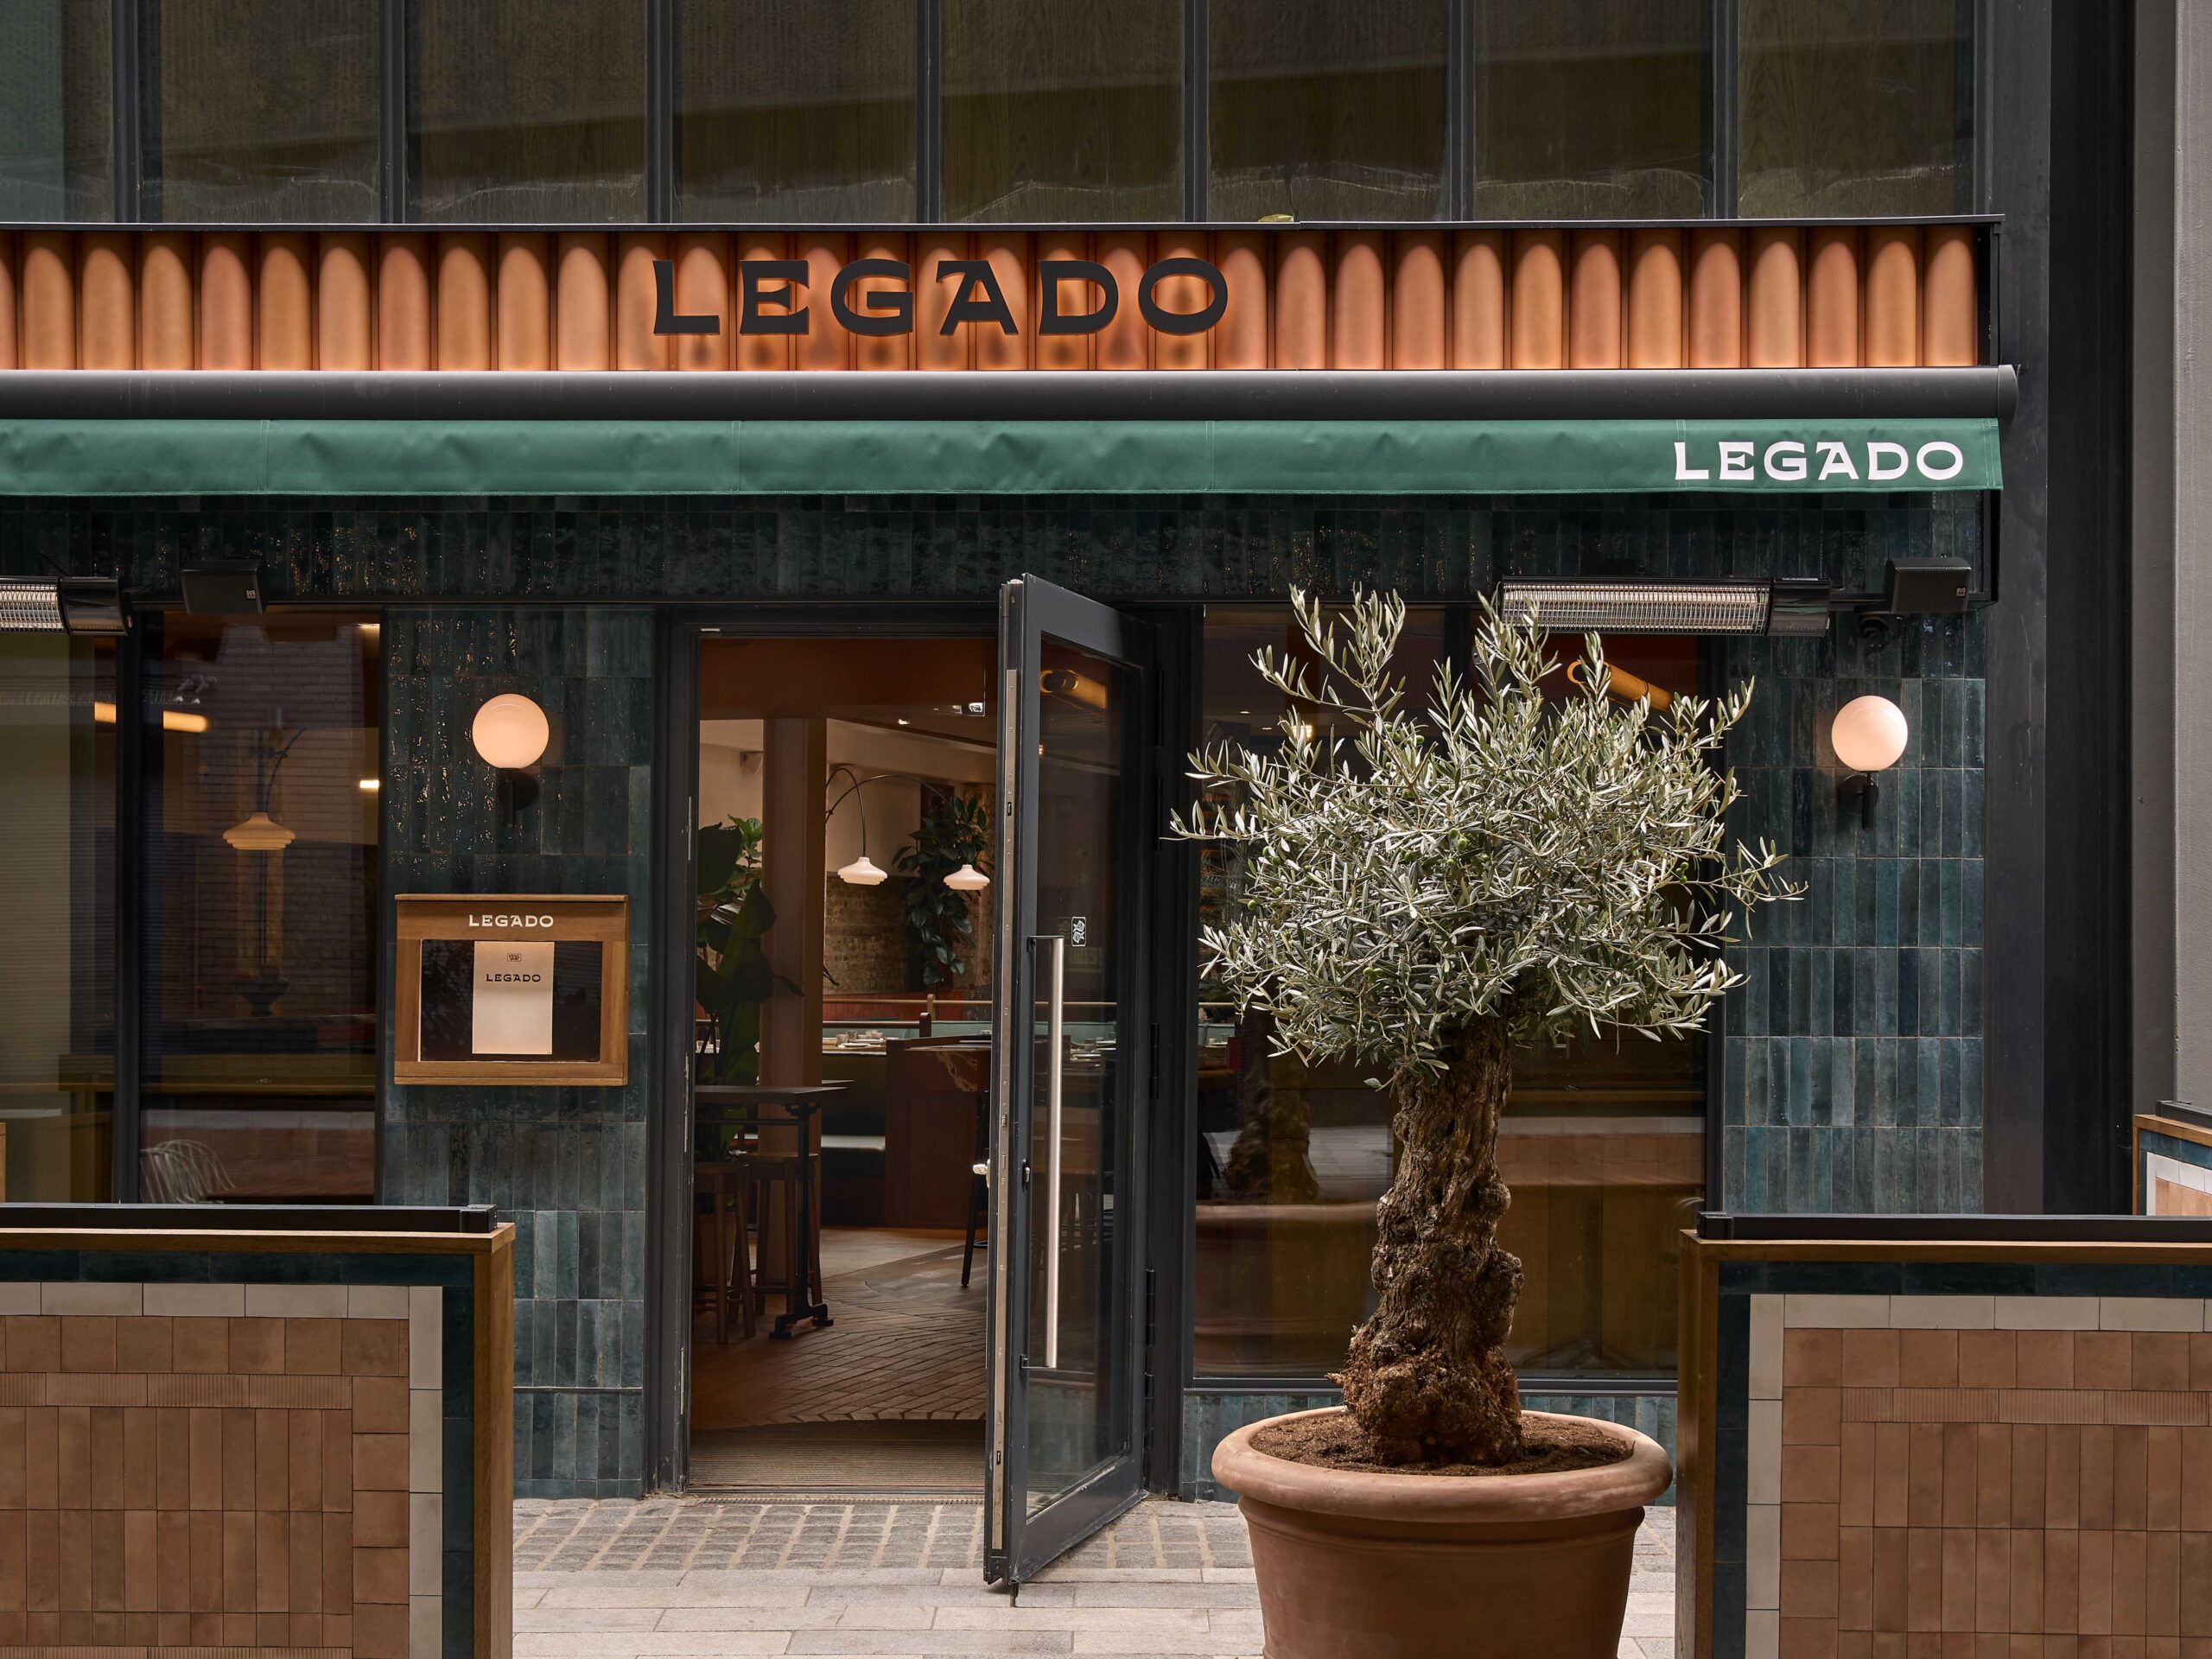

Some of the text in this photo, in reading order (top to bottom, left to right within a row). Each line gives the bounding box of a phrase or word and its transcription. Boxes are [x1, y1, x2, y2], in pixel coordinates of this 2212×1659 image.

[652, 257, 1229, 336] LEGADO
[1674, 441, 1964, 481] LEGADO
[468, 914, 554, 928] LEGADO
[486, 973, 542, 982] LEGADO
